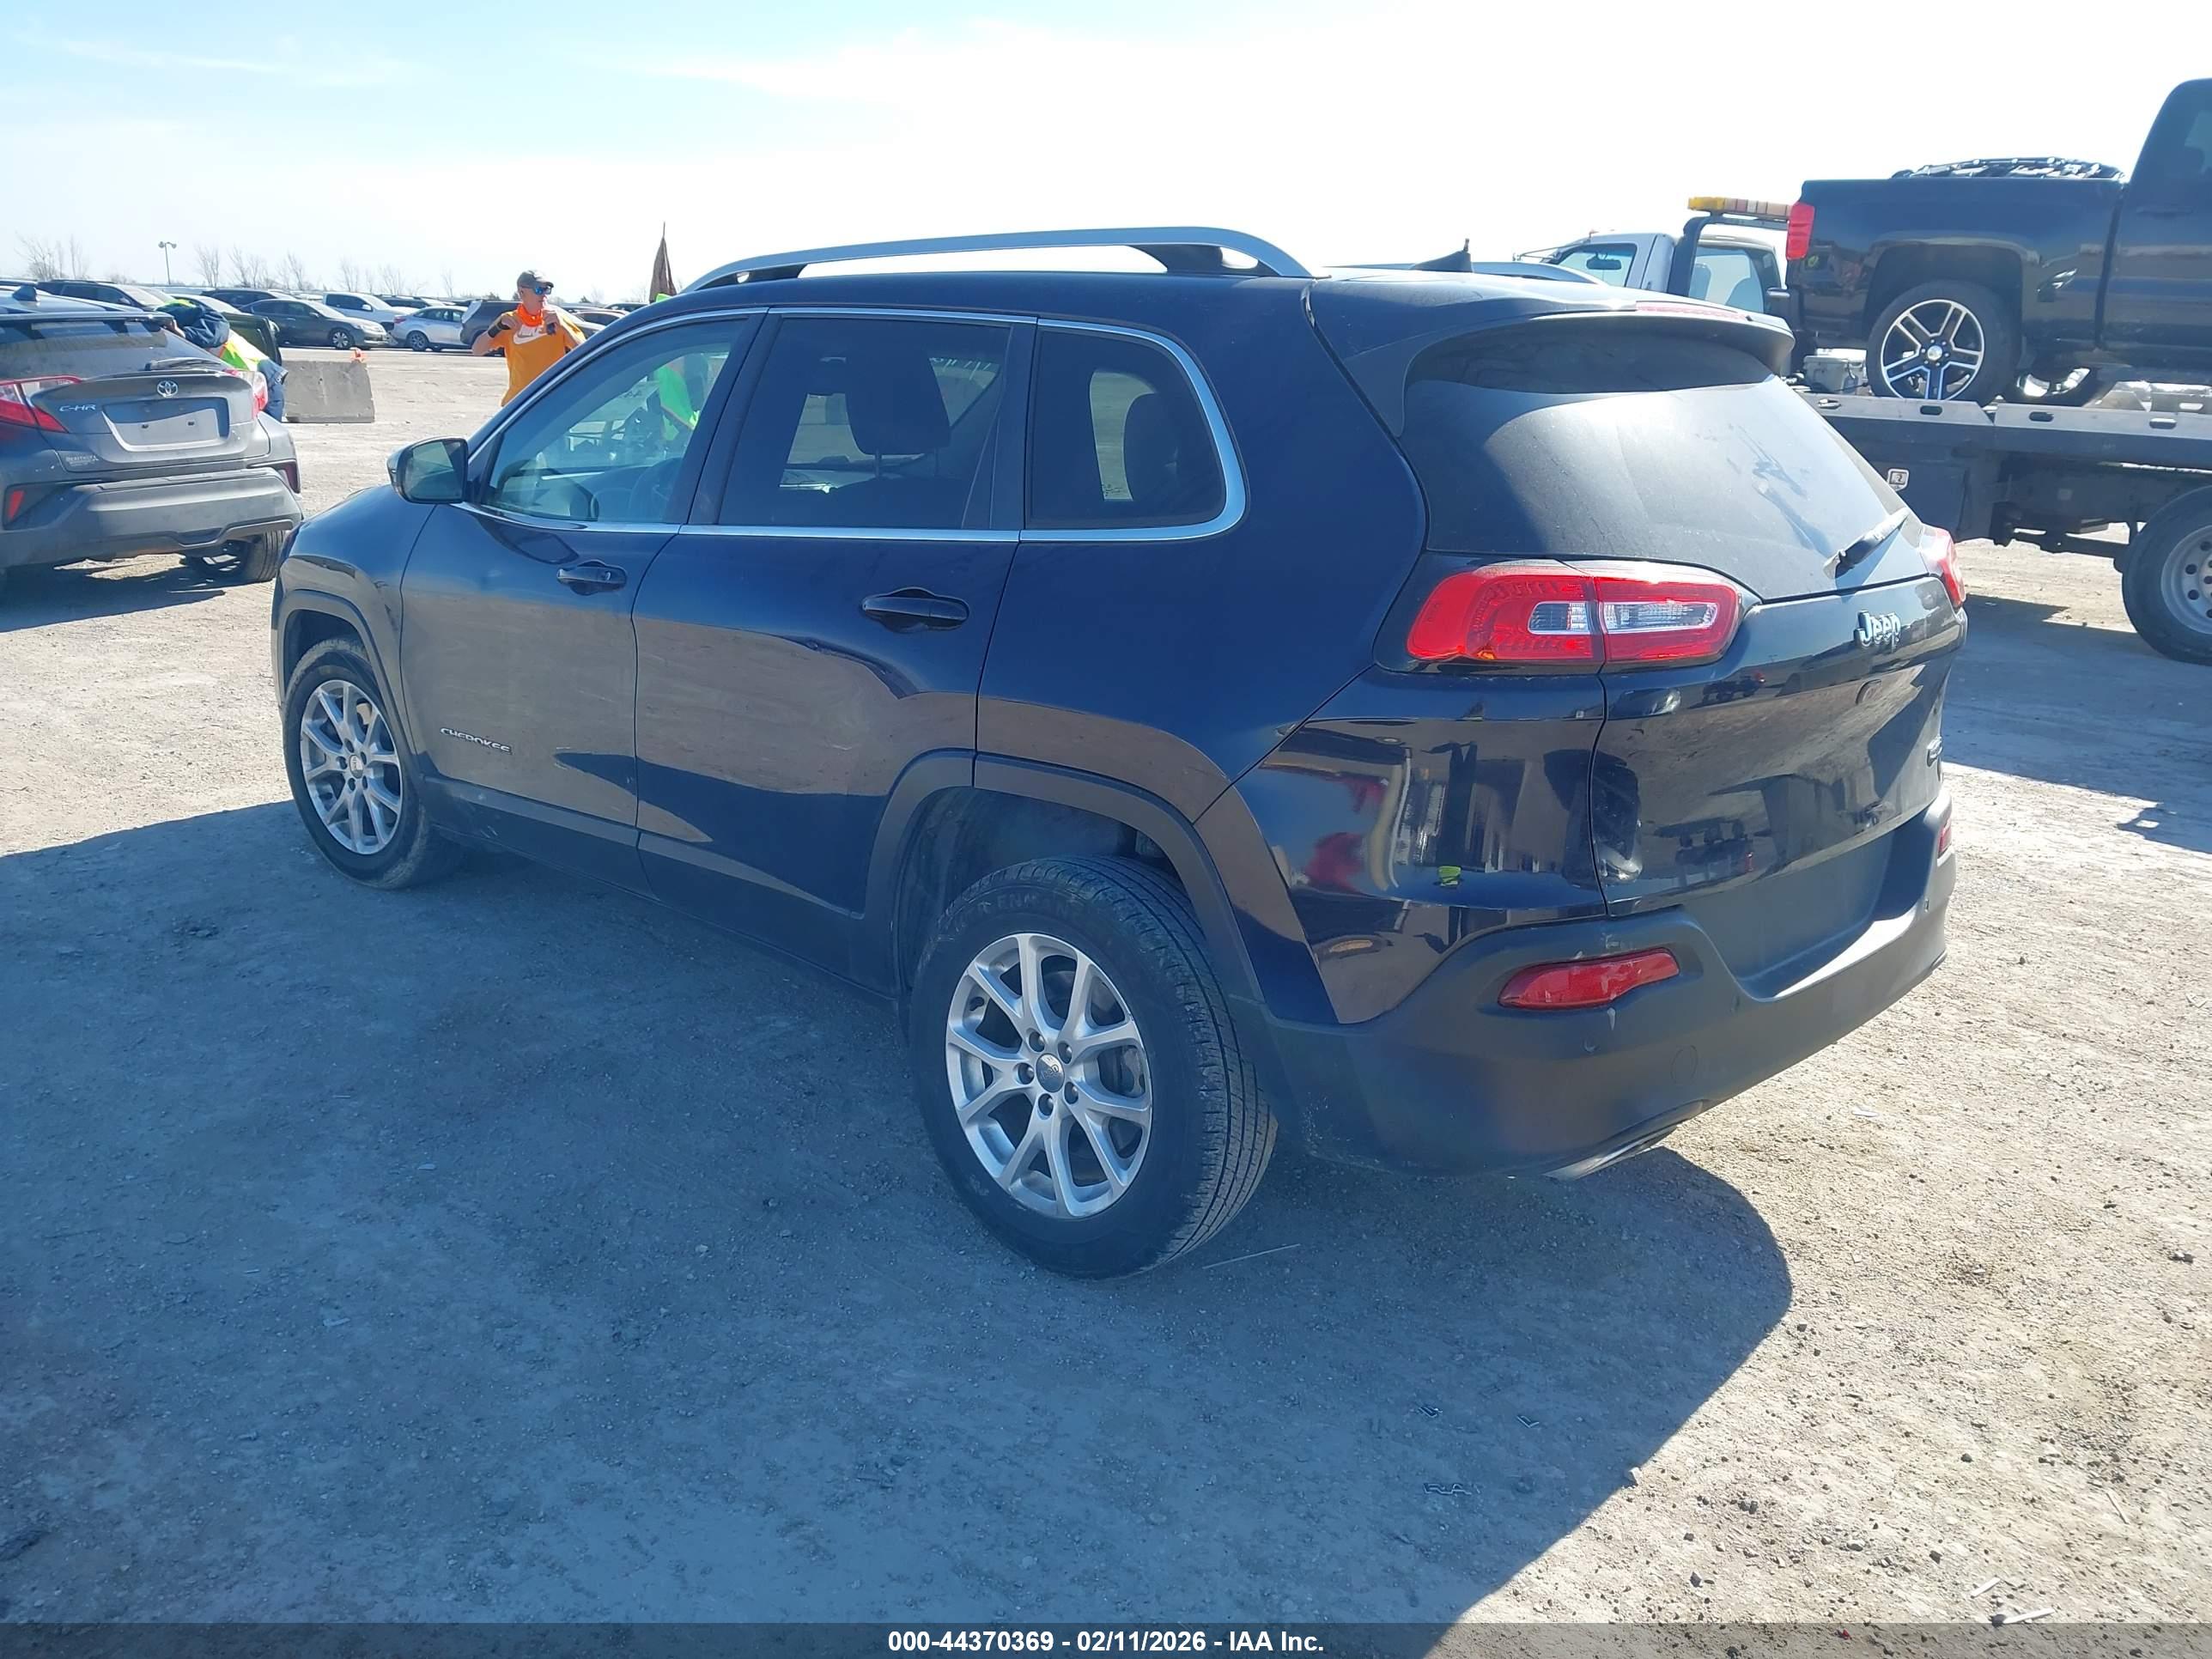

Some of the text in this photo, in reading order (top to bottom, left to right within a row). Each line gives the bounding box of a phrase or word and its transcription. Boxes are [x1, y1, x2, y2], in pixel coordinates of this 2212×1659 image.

[59, 404, 97, 412] C-HR
[1854, 610, 1901, 648] Jeep
[440, 727, 511, 753] CHEROKEE
